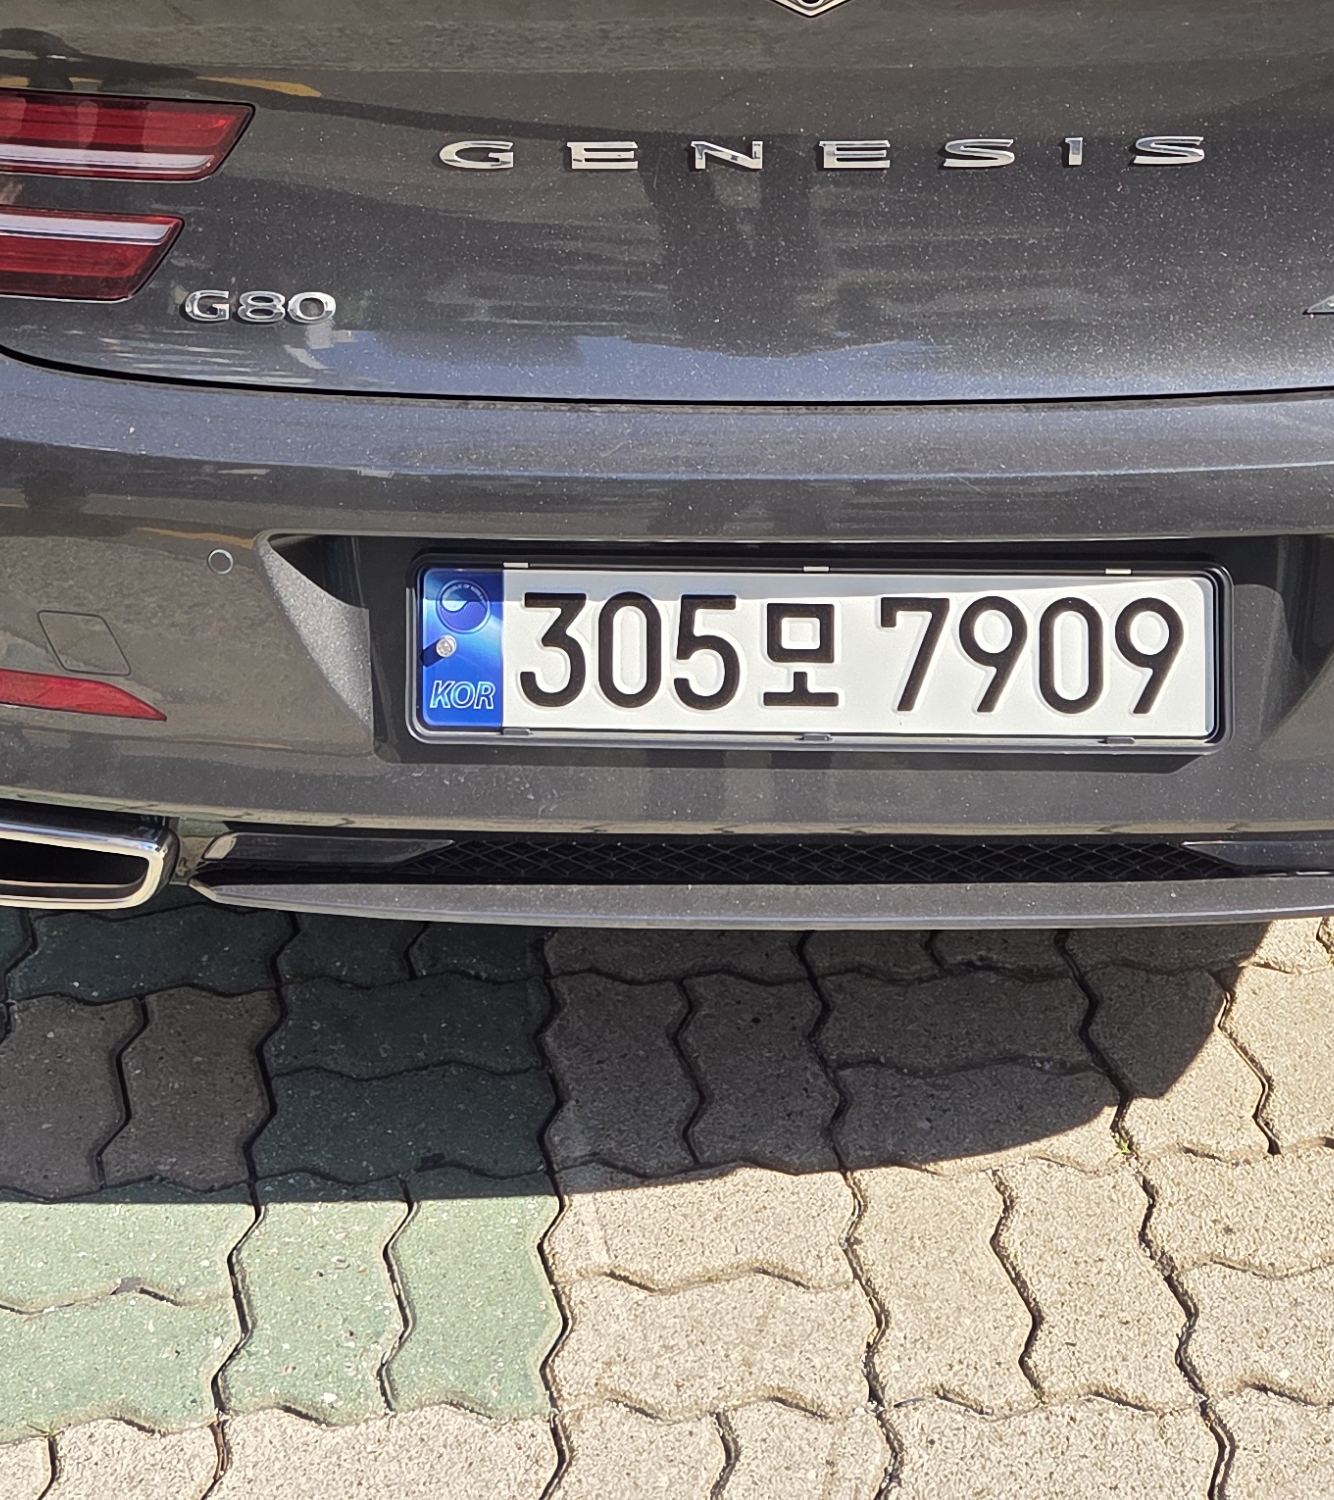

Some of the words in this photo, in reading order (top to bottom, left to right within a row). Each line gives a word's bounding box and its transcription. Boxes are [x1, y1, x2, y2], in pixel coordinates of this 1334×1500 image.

[438, 136, 1207, 172] GENESIS
[184, 289, 337, 324] G80
[518, 591, 840, 709] 305모
[879, 594, 1186, 717] 7909
[429, 680, 496, 710] KOR
